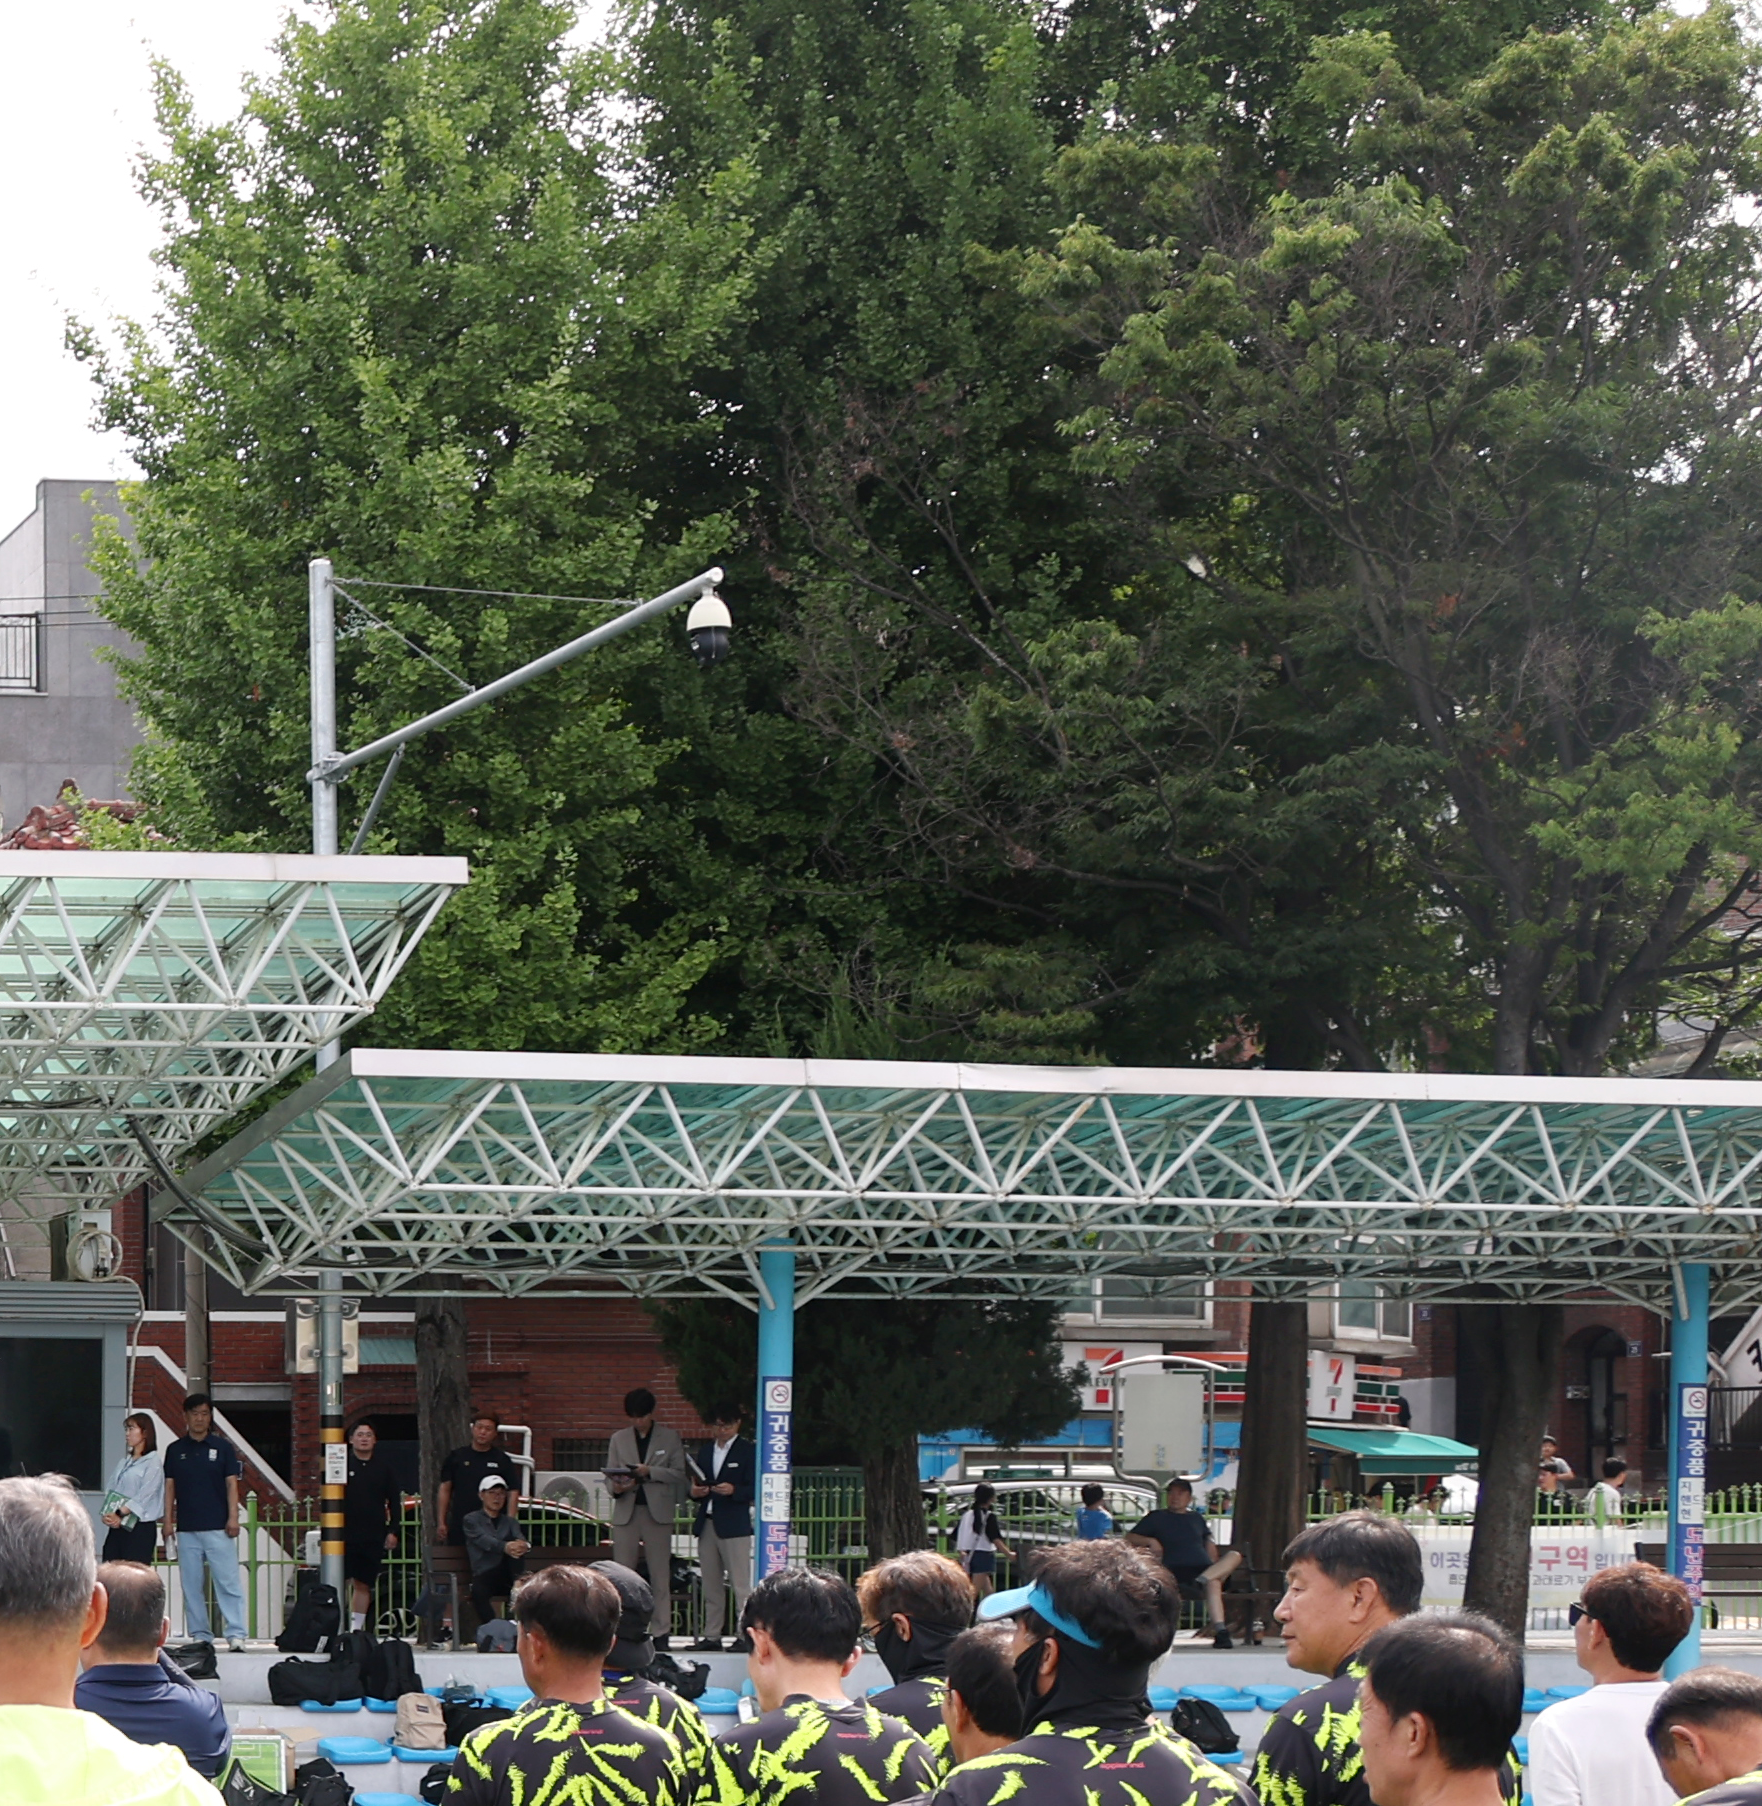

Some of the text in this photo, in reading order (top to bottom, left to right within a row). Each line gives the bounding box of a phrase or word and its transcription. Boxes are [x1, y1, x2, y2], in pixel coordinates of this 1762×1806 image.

[768, 1414, 790, 1472] 귀중품
[1686, 1420, 1706, 1476] 귀중품
[1529, 1546, 1589, 1571] 구역
